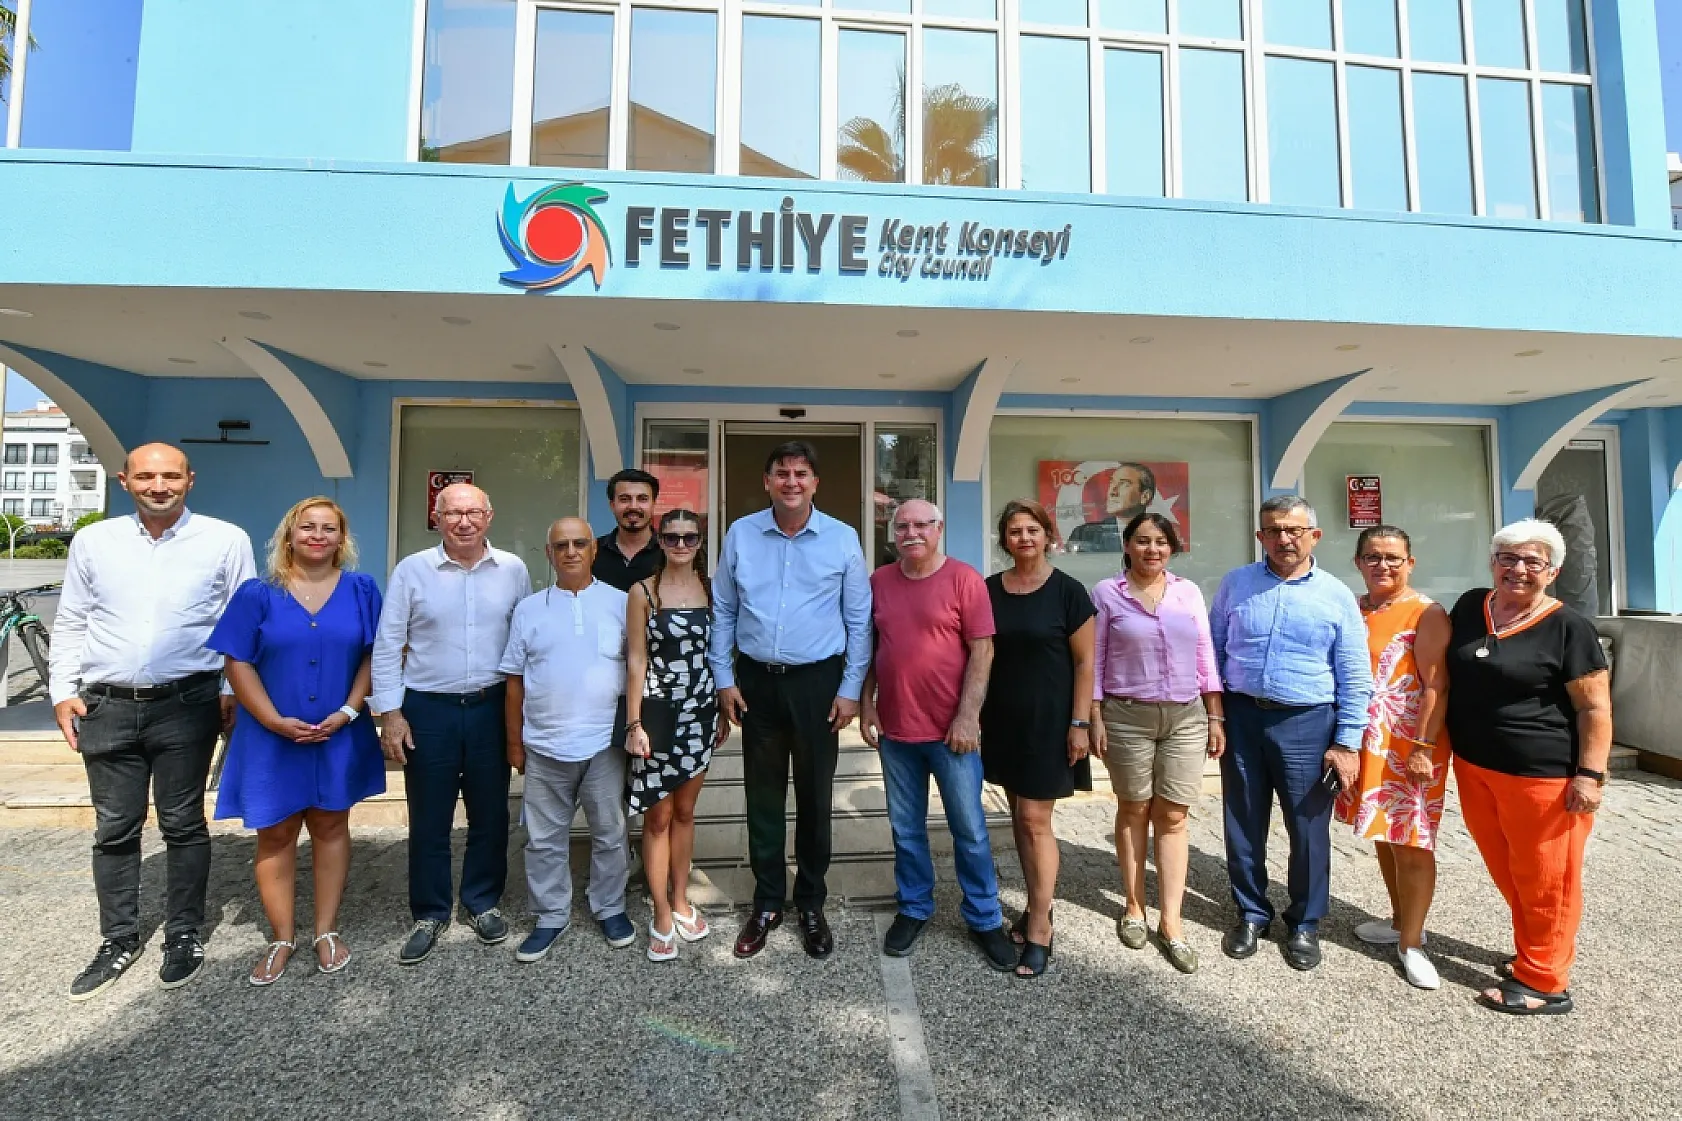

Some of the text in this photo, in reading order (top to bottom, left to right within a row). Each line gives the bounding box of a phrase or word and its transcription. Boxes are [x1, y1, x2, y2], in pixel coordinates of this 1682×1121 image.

[625, 196, 869, 272] FETHİYE
[880, 218, 1072, 264] Kent Konseyi
[880, 250, 993, 281] City Council
